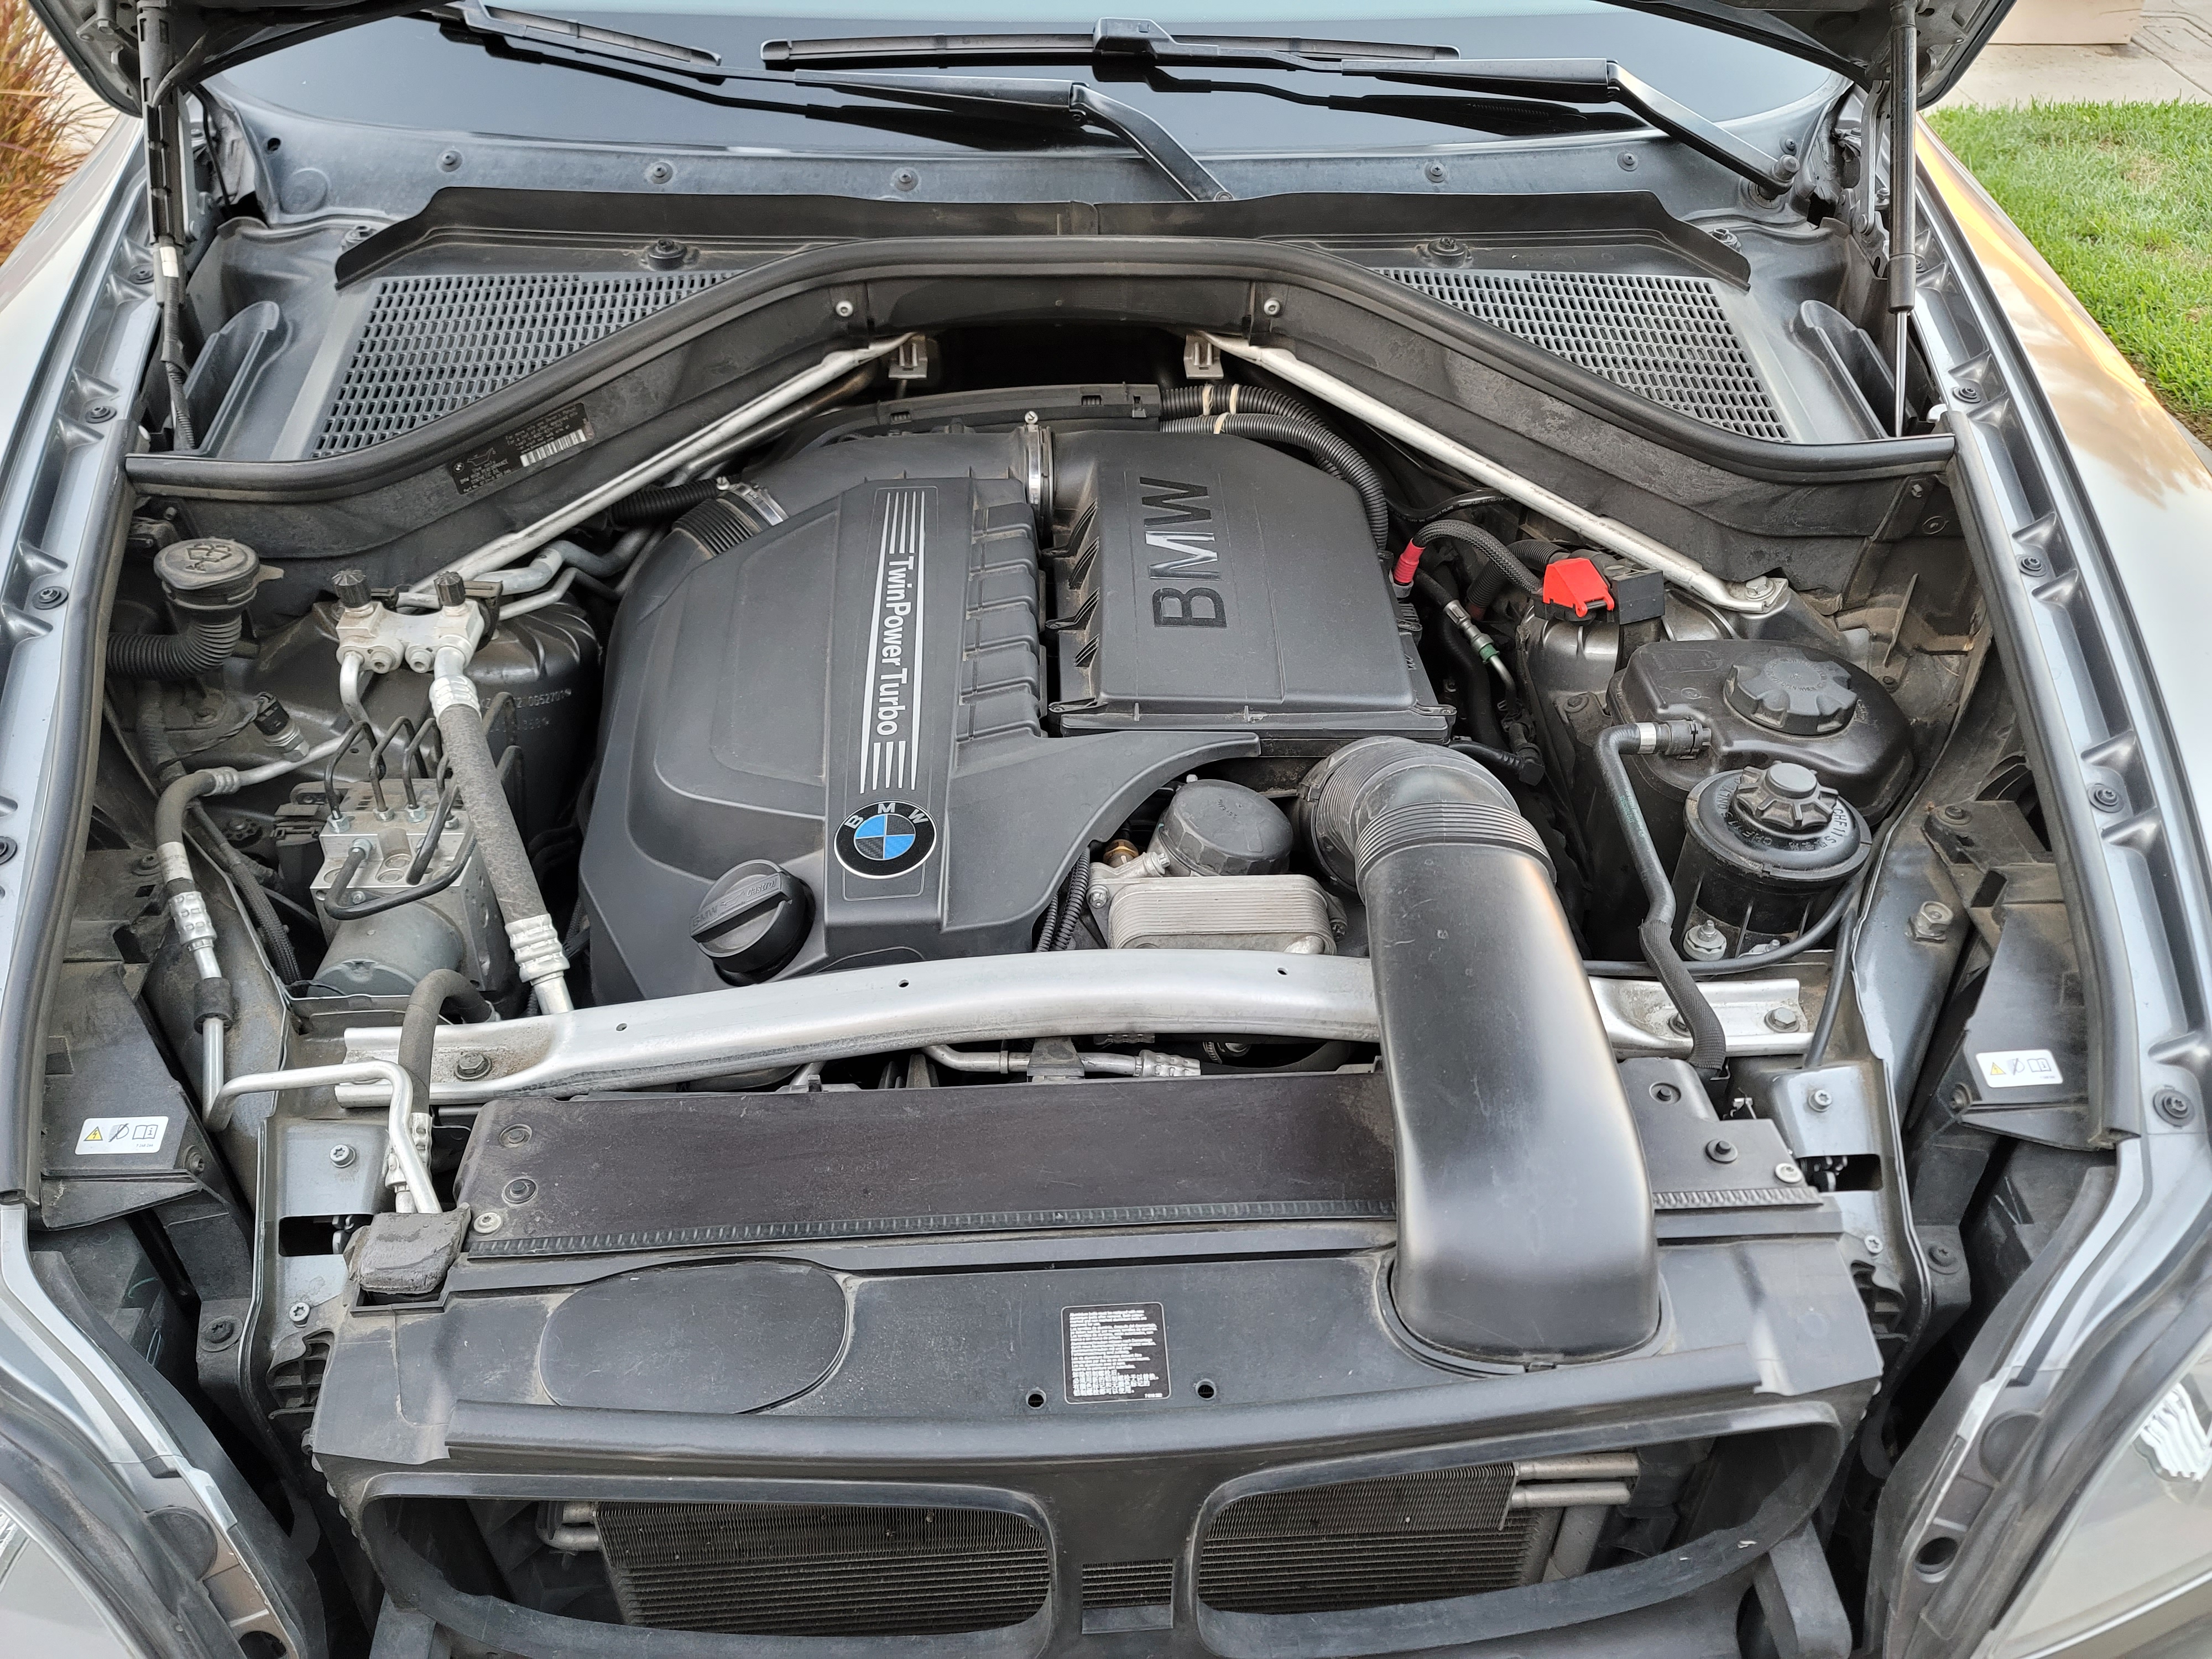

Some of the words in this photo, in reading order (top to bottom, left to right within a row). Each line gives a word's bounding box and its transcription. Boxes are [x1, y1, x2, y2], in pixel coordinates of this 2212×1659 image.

[1139, 476, 1227, 629] BMW
[881, 556, 914, 667] TwinPower
[877, 667, 907, 736] Turbo
[844, 802, 929, 829] BMW
[1716, 785, 1732, 810] ONLY
[1831, 827, 1846, 837] 11
[1833, 808, 1848, 827] CHF
[693, 905, 718, 927] BMW
[747, 878, 777, 898] Castrol
